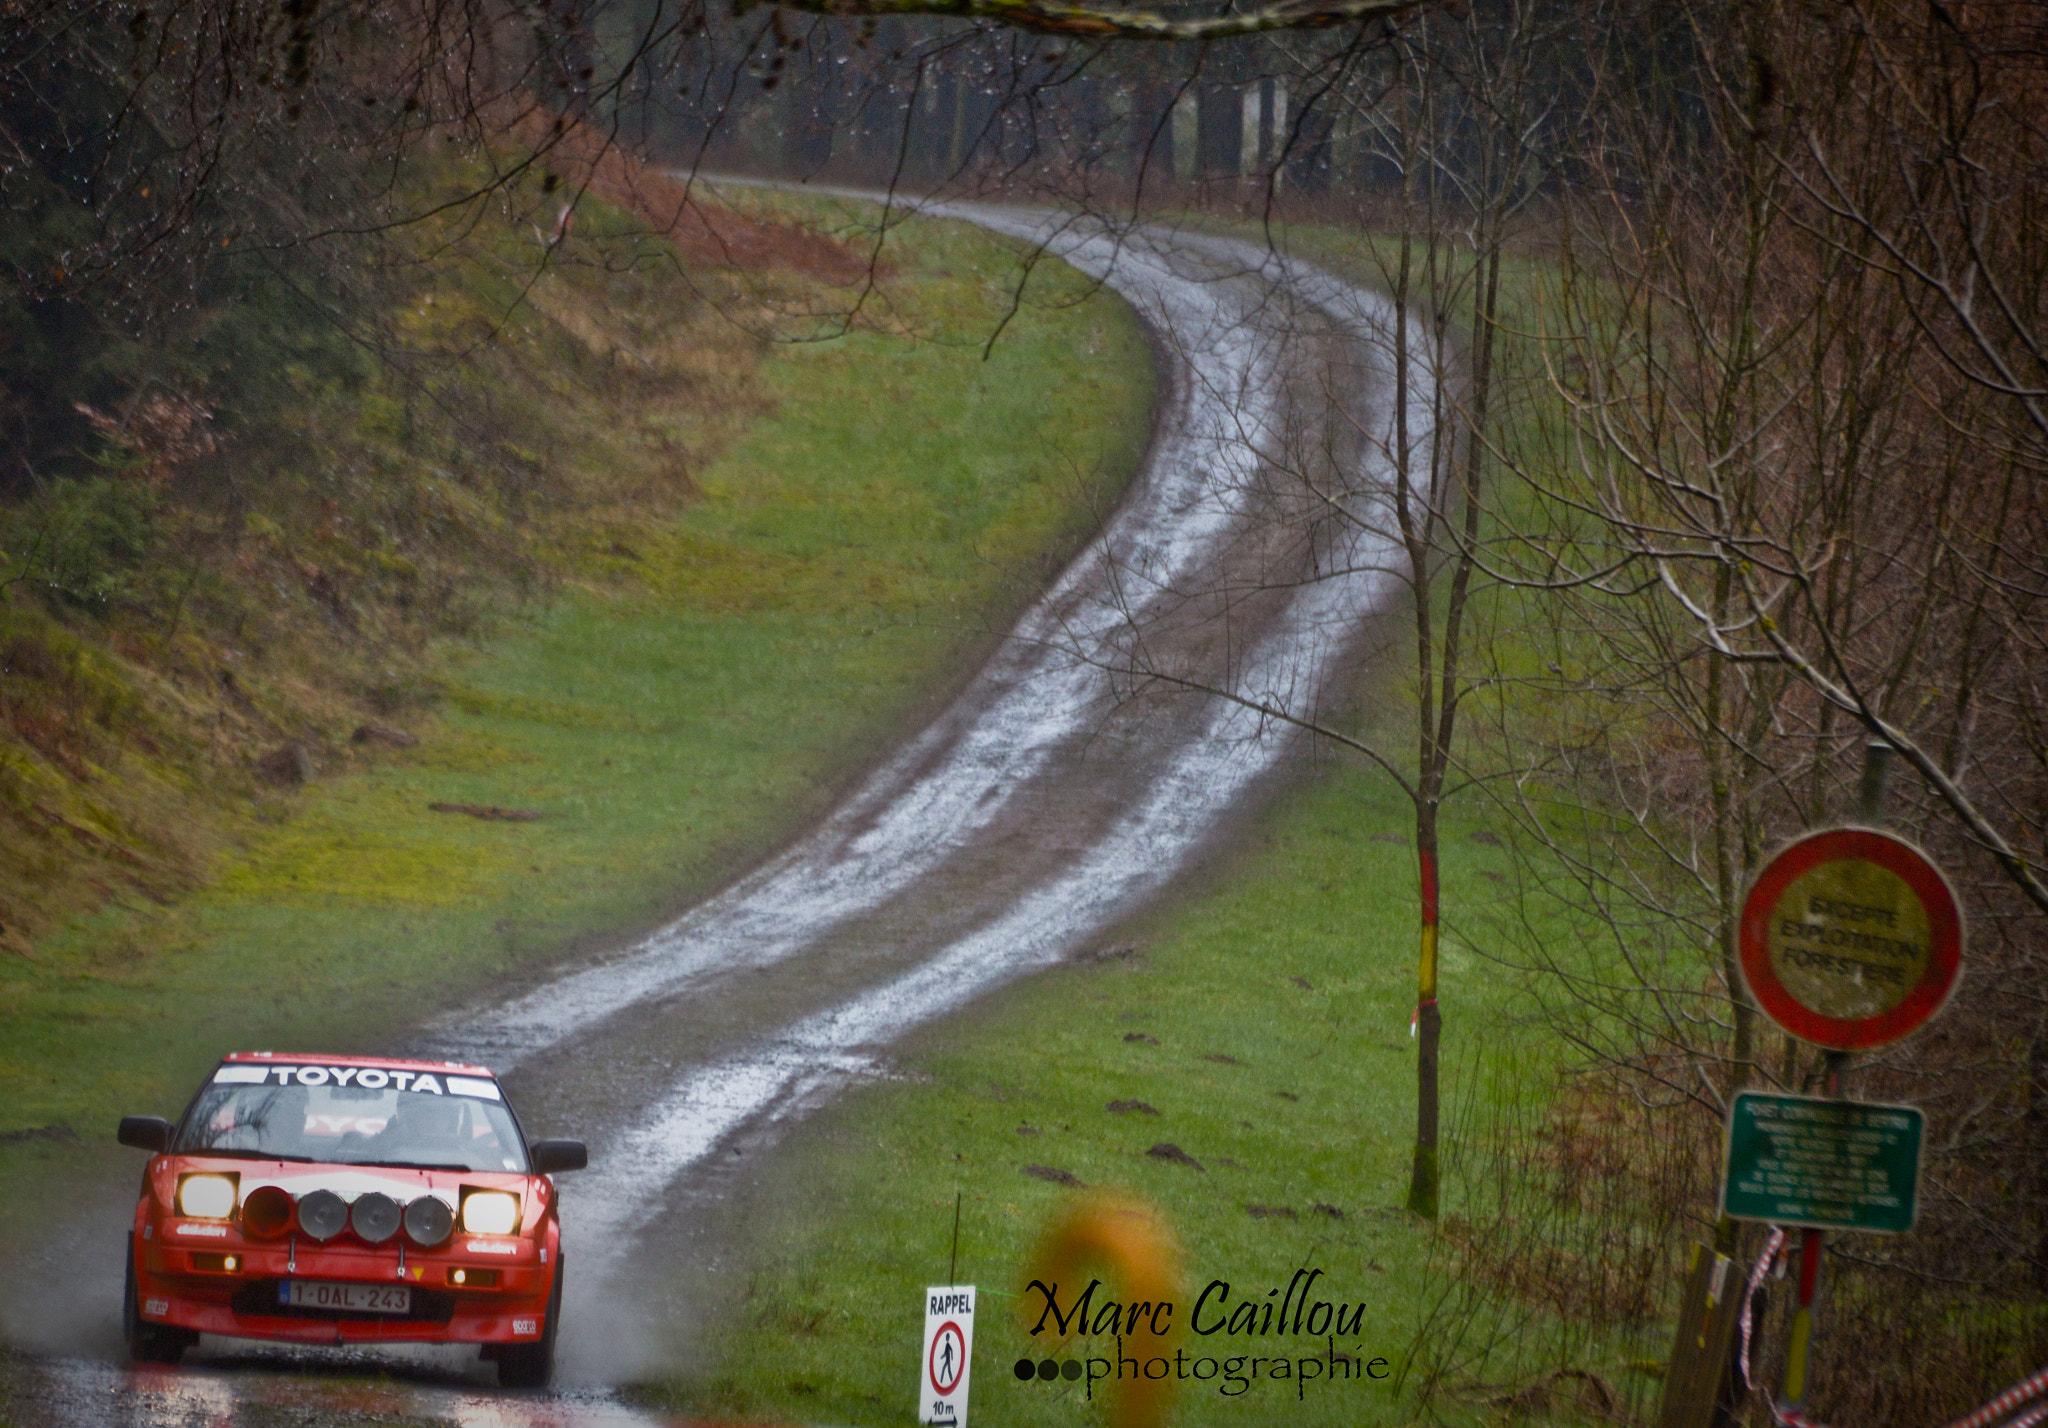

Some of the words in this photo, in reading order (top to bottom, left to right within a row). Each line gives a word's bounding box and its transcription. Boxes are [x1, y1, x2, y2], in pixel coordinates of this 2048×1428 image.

[271, 1066, 443, 1095] TOYOTA
[929, 1294, 972, 1316] RAPPEL
[933, 1401, 944, 1416] 10
[945, 1404, 954, 1415] m
